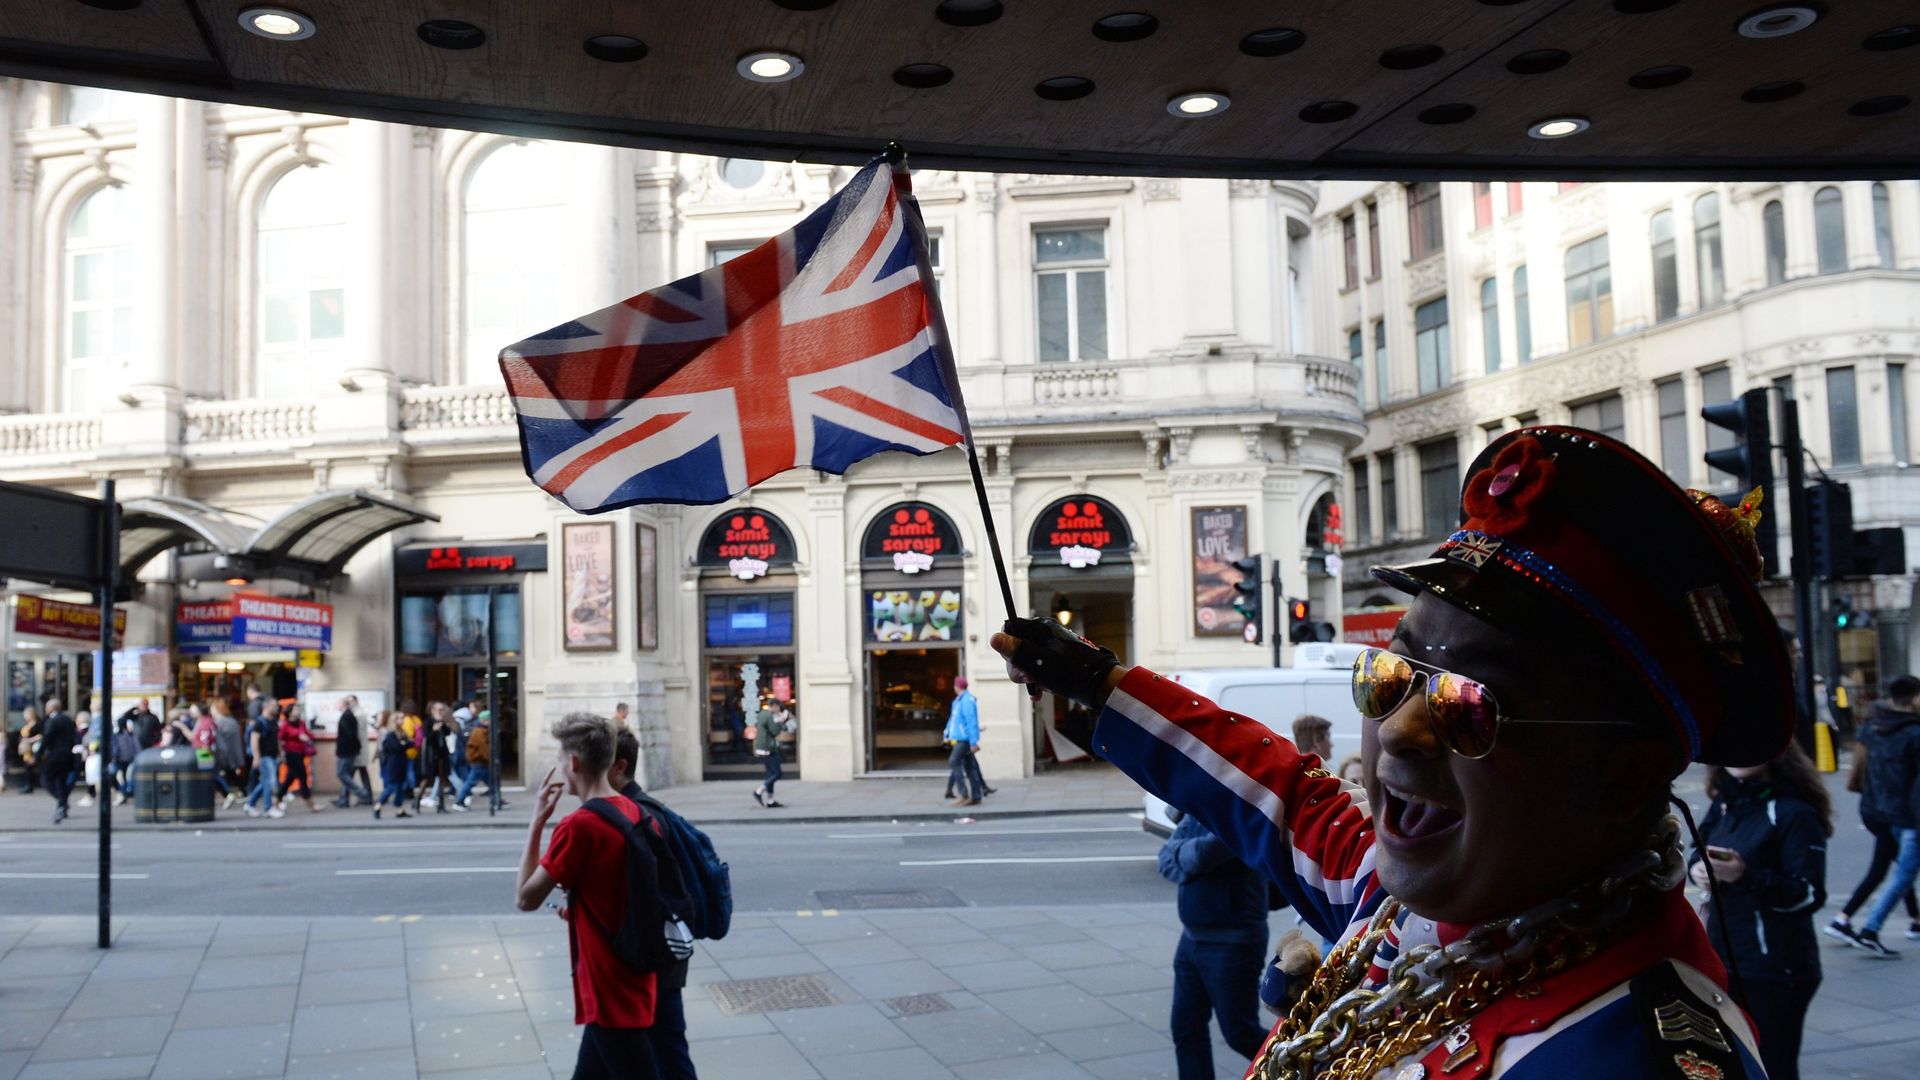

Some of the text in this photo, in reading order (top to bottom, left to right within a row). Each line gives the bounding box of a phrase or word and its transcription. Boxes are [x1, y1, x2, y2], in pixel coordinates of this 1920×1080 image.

[1203, 514, 1233, 530] BAKED
[1198, 535, 1230, 557] LOVE
[568, 552, 598, 572] LOVE
[42, 606, 61, 621] BUY
[62, 609, 100, 626] TICKETS
[184, 604, 232, 619] THEATR
[239, 599, 284, 618] THEATRE
[286, 604, 321, 621] TICKETS
[191, 624, 232, 637] MONEY
[246, 618, 323, 637] MONEY EXCHANGE
